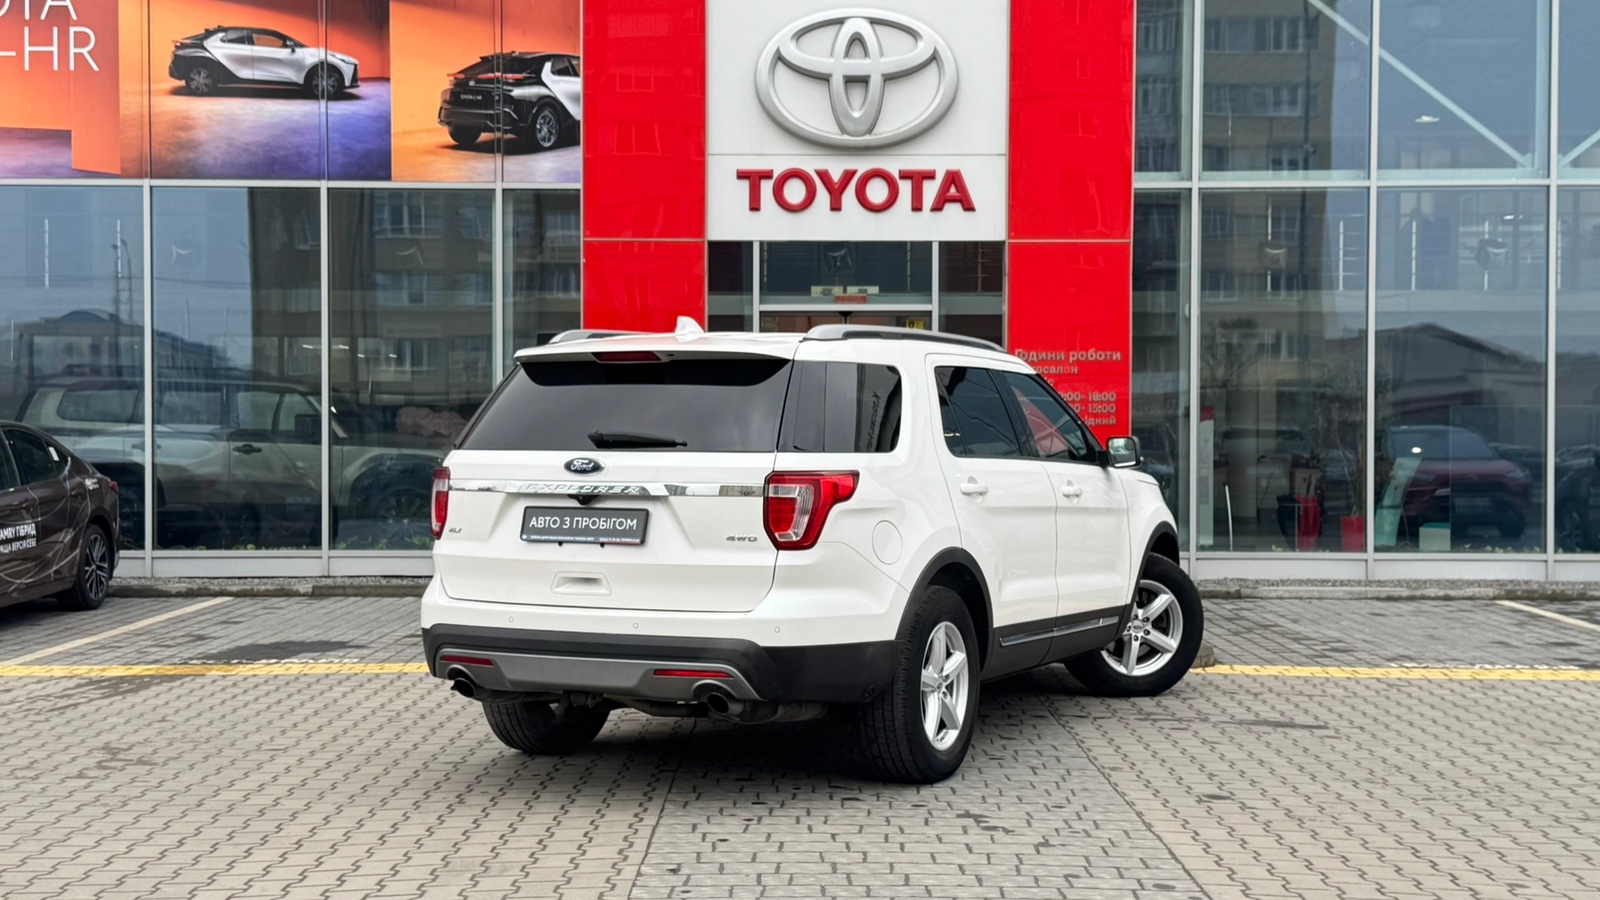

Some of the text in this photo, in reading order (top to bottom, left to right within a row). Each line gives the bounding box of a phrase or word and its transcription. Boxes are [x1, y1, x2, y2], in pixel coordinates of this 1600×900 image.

[736, 167, 976, 213] TOYOTA
[1069, 348, 1122, 363] роботи
[1088, 391, 1117, 401] 18:00
[1088, 403, 1117, 413] 15:00
[570, 459, 595, 471] Ford
[525, 483, 641, 494] EXPLORER
[529, 516, 560, 529] АВТО
[573, 517, 637, 530] ПРОБІГОМ
